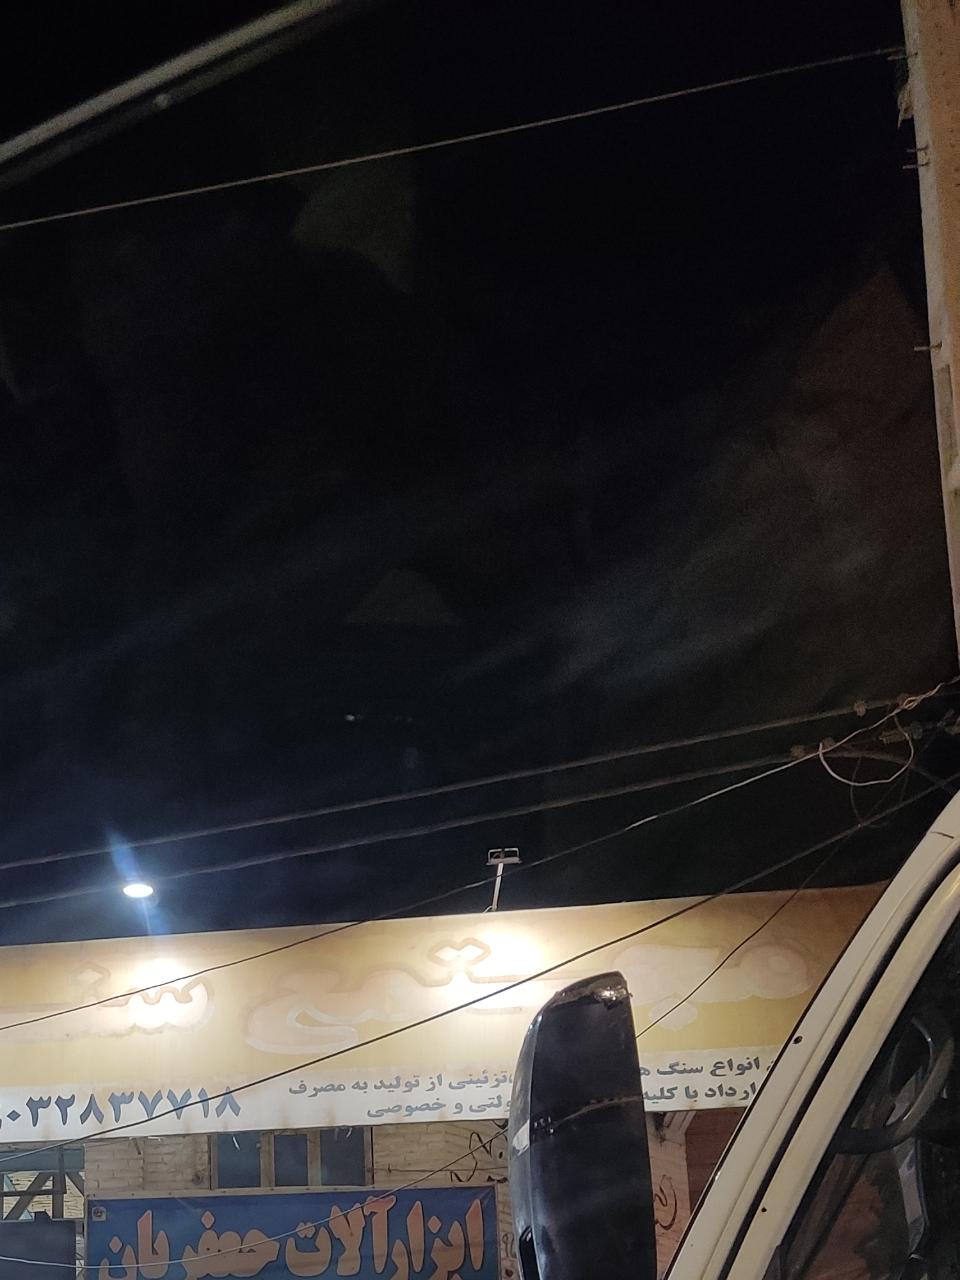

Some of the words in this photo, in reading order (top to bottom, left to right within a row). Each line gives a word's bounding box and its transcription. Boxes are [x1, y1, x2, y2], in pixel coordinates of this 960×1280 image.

[656, 1061, 704, 1077] سنگ
[709, 1056, 760, 1077] انواع
[288, 1080, 346, 1098] مصرف
[351, 1080, 368, 1094] به
[373, 1075, 420, 1093] تولید
[425, 1073, 442, 1092] از
[705, 1081, 757, 1101] ارداد
[643, 1086, 678, 1104] کلی
[684, 1085, 699, 1103] با
[367, 1097, 446, 1118] خصوصی
[453, 1101, 463, 1114] و
